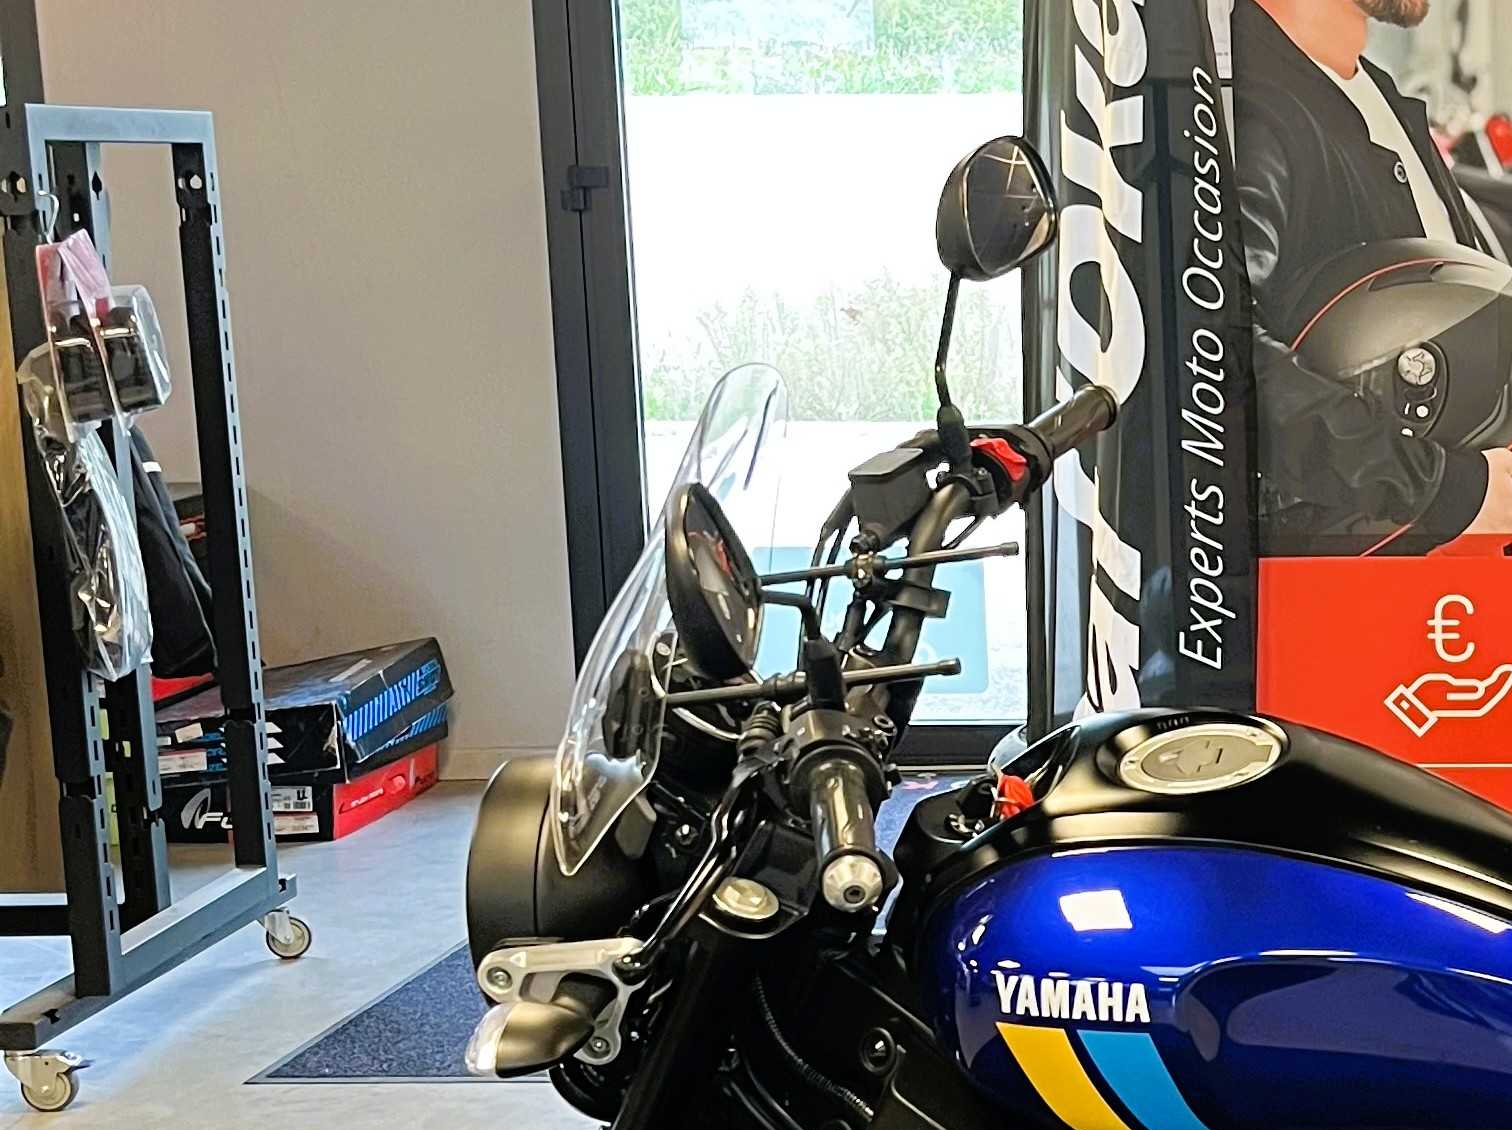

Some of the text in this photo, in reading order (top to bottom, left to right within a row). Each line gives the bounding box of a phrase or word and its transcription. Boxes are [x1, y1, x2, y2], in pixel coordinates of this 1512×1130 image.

[1179, 66, 1237, 670] Experts Moto Occasion
[990, 968, 1151, 1023] YAMAHA
